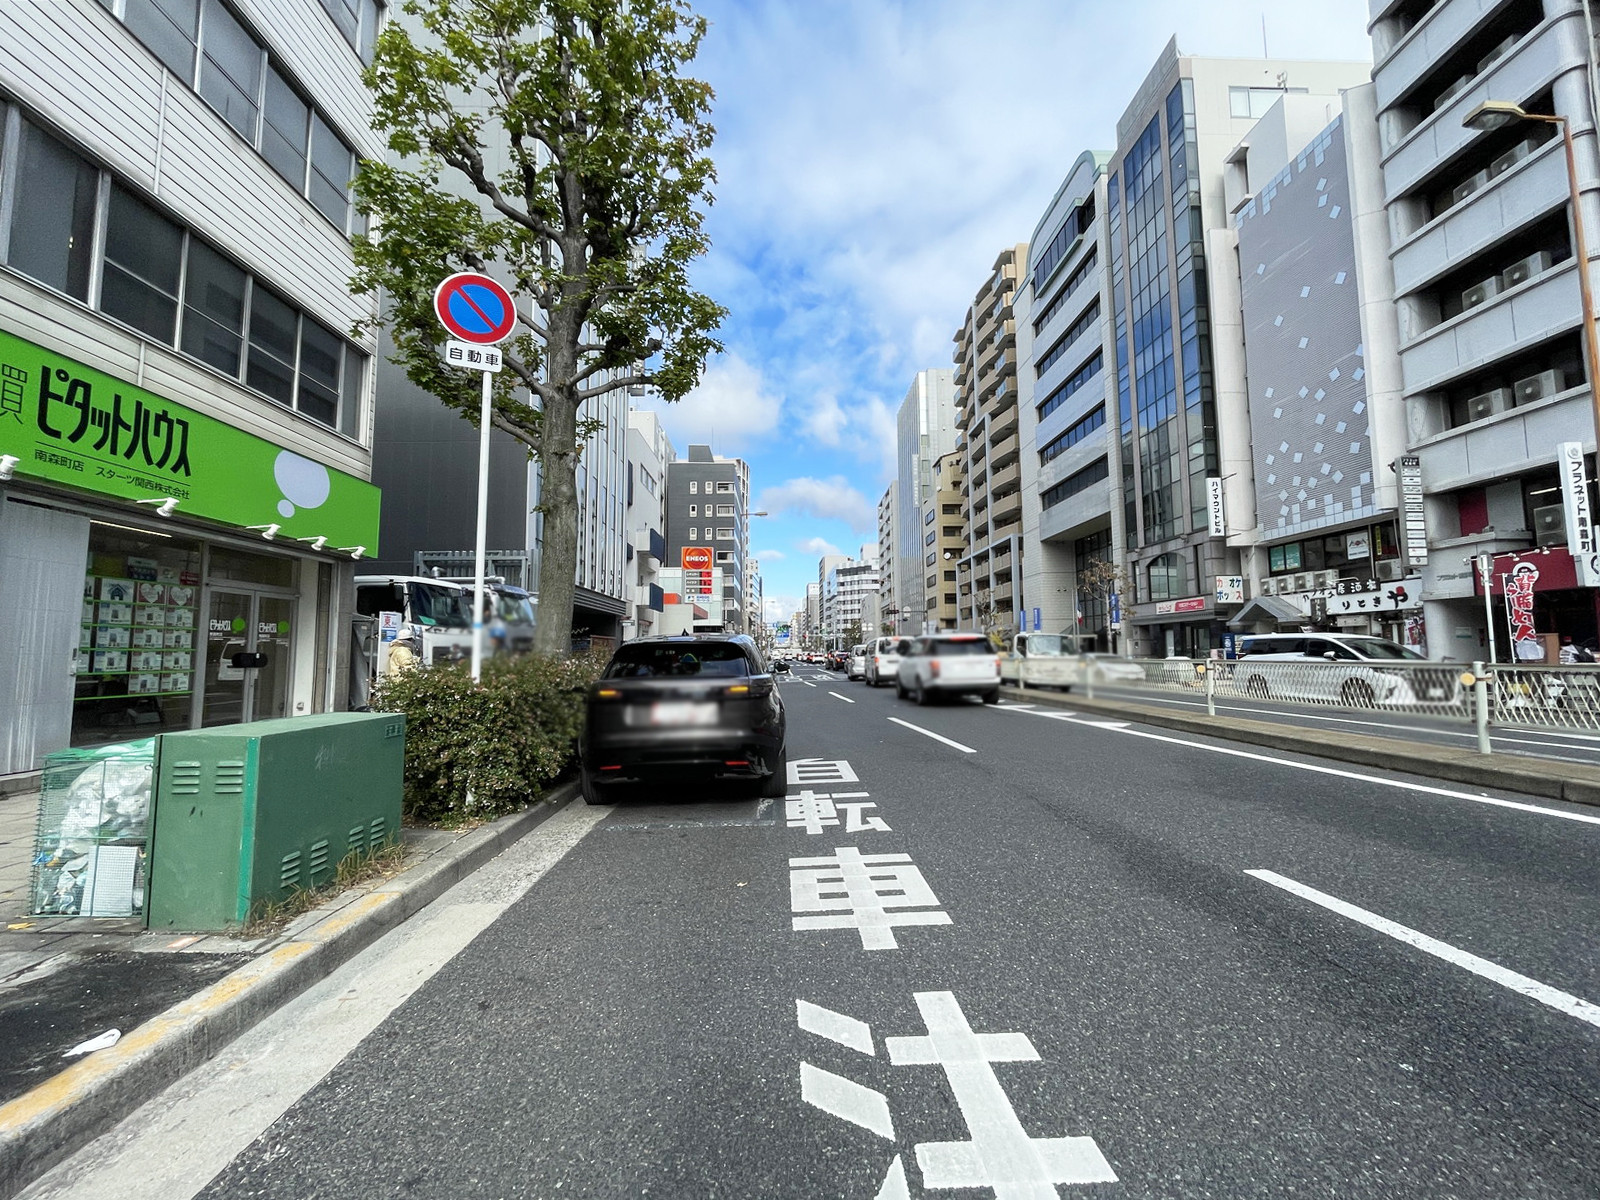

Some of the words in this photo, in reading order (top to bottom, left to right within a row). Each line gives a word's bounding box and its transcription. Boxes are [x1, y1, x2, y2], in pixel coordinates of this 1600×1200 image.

[450, 347, 499, 366] 自動車
[37, 365, 192, 478] ピタットハウス
[35, 449, 84, 473] 南森町店
[95, 466, 191, 500] スターツ関西株式会社
[1211, 481, 1222, 534] ハイマウントビル
